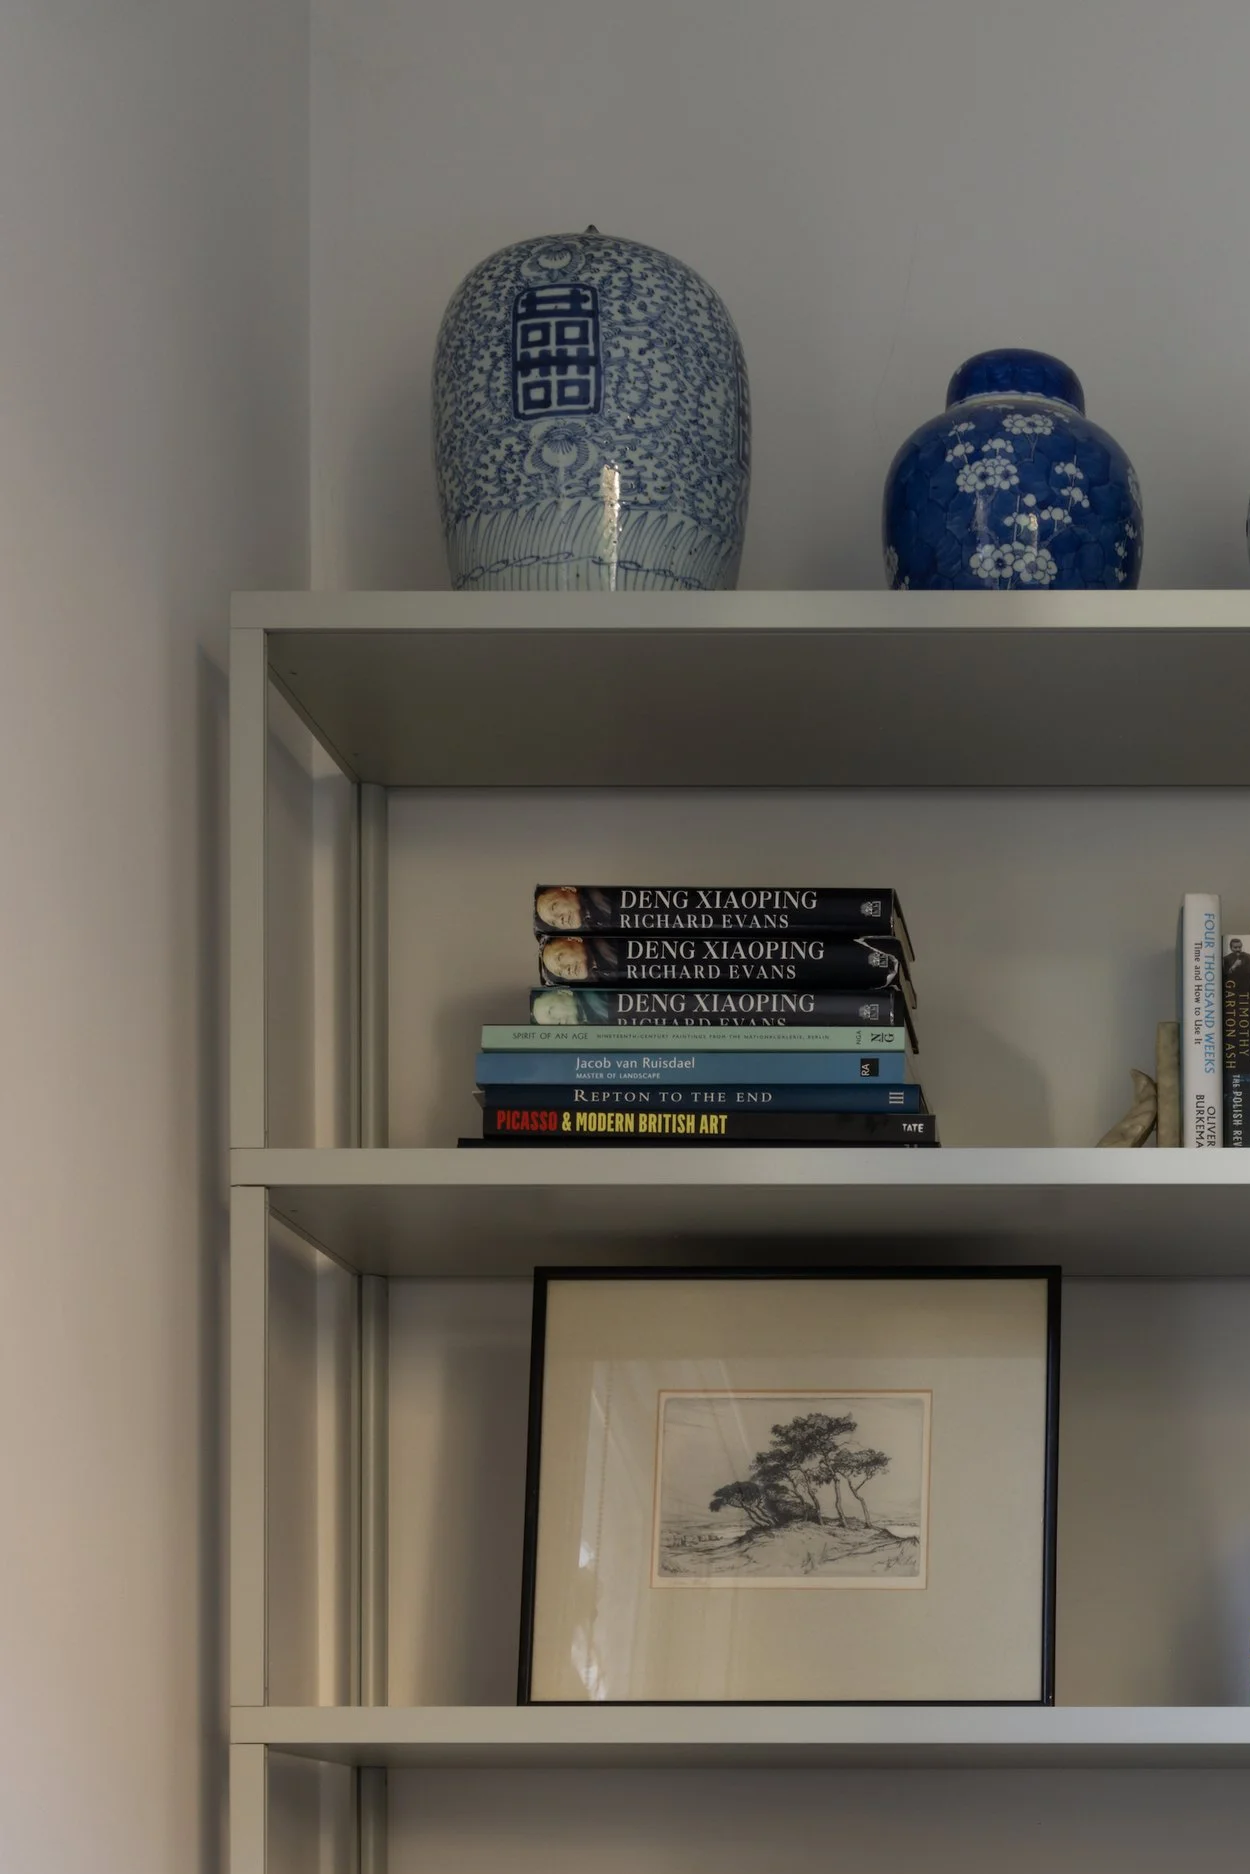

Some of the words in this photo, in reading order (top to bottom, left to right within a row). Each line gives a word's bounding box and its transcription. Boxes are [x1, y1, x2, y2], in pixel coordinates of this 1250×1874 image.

[620, 890, 689, 910] DENG
[695, 890, 818, 910] XIAOPING
[620, 914, 714, 929] RICHARD
[722, 914, 790, 929] EVANS
[1204, 912, 1215, 948] FOUR
[626, 940, 696, 960] DENG
[702, 940, 825, 960] XIAOPING
[626, 965, 721, 979] RICHARD
[729, 965, 797, 979] EVANS
[1204, 955, 1216, 1029] THOUSAND
[617, 993, 686, 1013] DENG
[693, 993, 816, 1013] XIAOPING
[1239, 992, 1250, 1056] TIMOTHY
[512, 1032, 536, 1040] SPIRIT
[540, 1032, 551, 1040] OF
[555, 1032, 568, 1040] AN
[572, 1032, 589, 1040] AGE
[1204, 1032, 1216, 1074] WEEKS
[576, 1057, 612, 1071] Jacob
[616, 1059, 637, 1069] van
[642, 1057, 695, 1069] Ruisdael
[573, 1089, 650, 1102] REPTON
[659, 1091, 682, 1102] TO
[691, 1092, 726, 1103] THE
[736, 1092, 773, 1103] END
[496, 1110, 558, 1131] PICASSO
[562, 1112, 572, 1131] &
[575, 1112, 635, 1132] MODERN
[638, 1113, 696, 1134] BRITISH
[699, 1115, 728, 1135] ART
[903, 1123, 924, 1133] TATE
